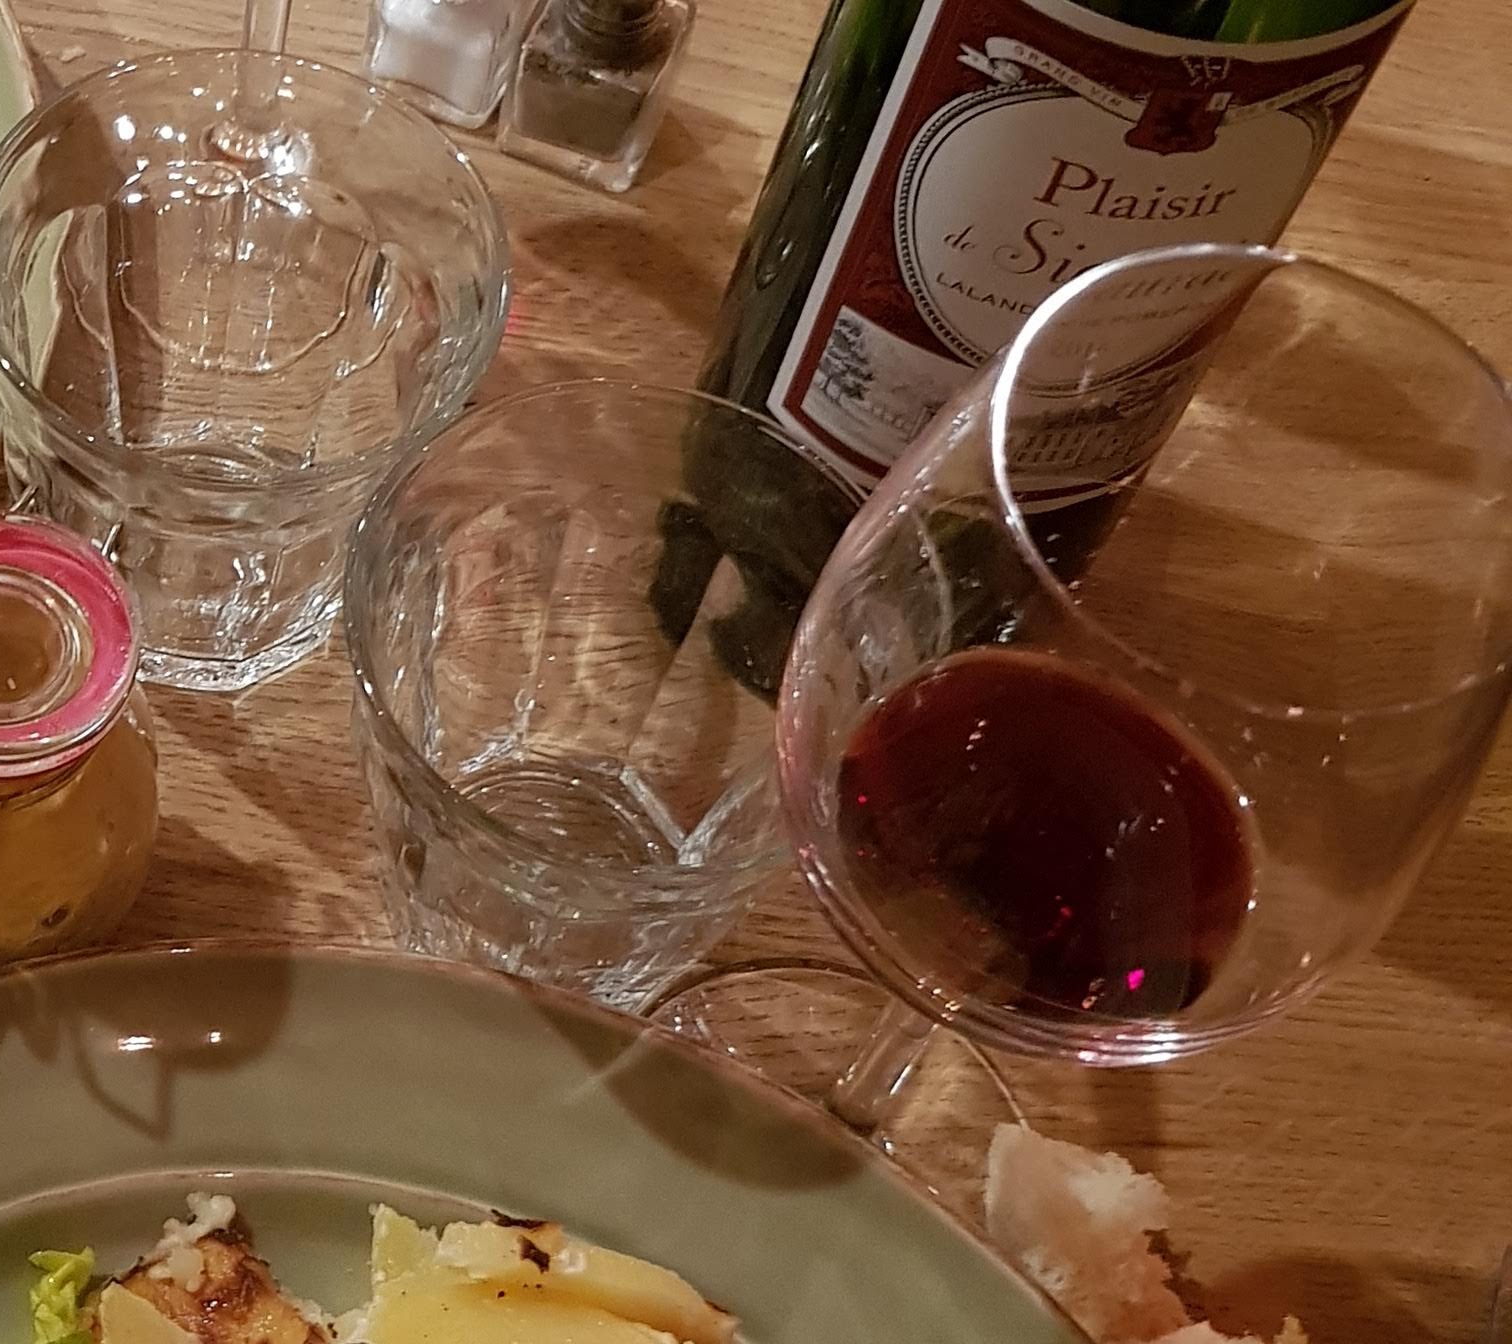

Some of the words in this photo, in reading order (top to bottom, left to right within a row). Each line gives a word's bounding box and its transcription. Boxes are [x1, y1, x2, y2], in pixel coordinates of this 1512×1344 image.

[1032, 156, 1237, 221] Plaisir
[942, 224, 978, 252] de
[935, 271, 1040, 316] LALAND
